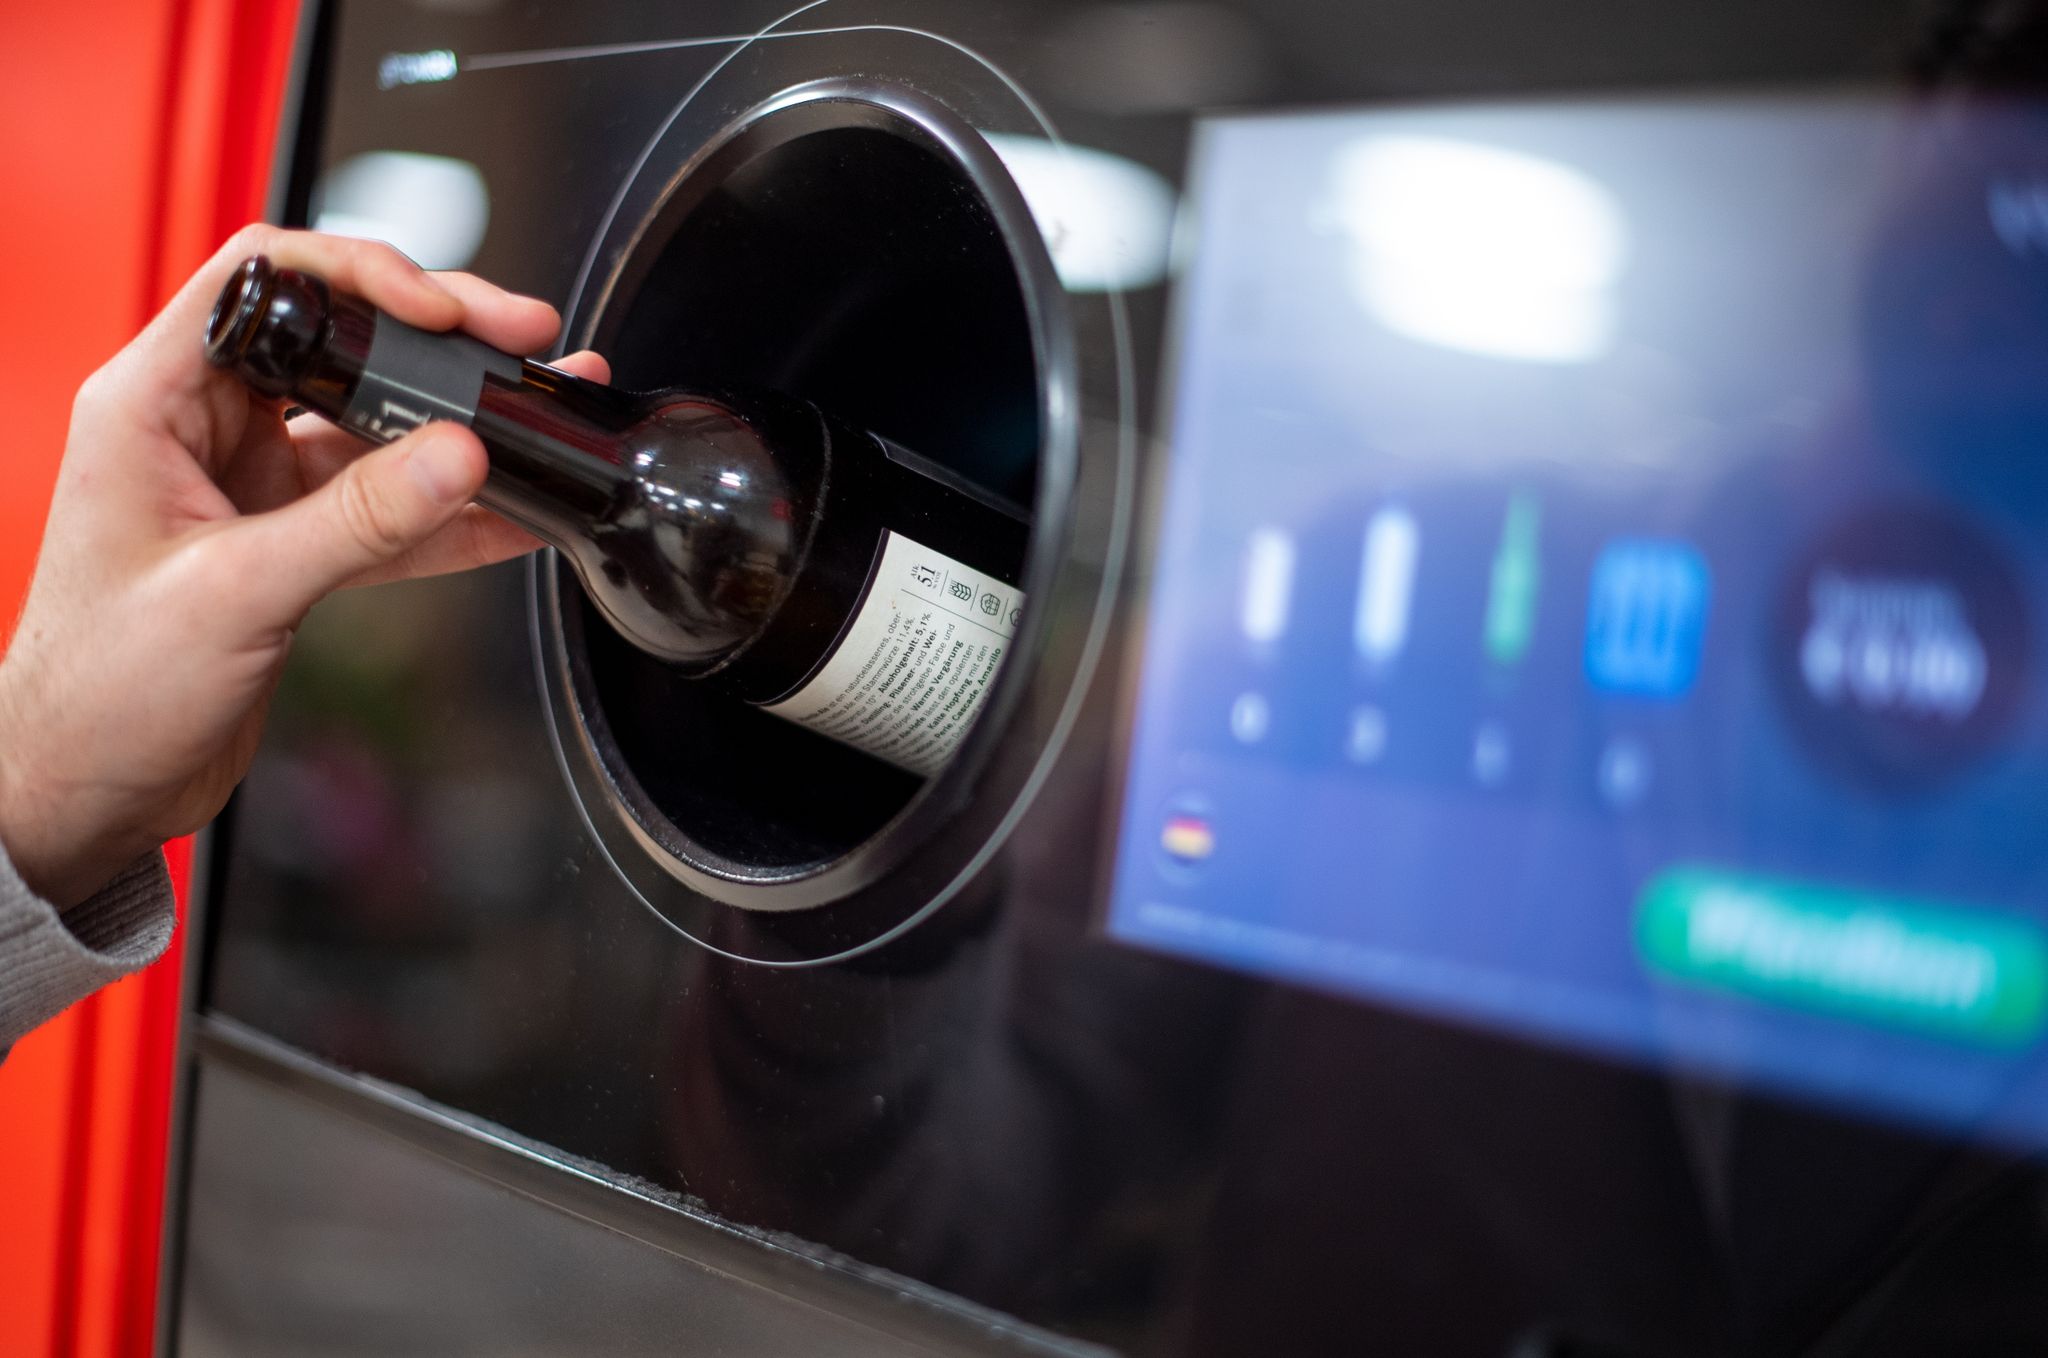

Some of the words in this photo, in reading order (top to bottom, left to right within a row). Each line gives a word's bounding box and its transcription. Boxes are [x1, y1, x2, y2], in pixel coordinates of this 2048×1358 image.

[887, 611, 901, 634] ober-
[853, 691, 866, 701] mit
[862, 645, 899, 691] Stammwürze
[878, 636, 919, 693] Alkoholgehalt:
[889, 667, 915, 698] Pilsener-
[914, 649, 927, 666] und
[922, 629, 937, 648] Wei-
[893, 704, 904, 713] die
[902, 666, 932, 704] strohgelbe
[928, 641, 946, 665] Farbe
[943, 623, 955, 640] und
[910, 685, 935, 709] Warme
[931, 639, 962, 683] Vergärung
[927, 712, 946, 729] Kalte
[942, 677, 972, 712] Hopfung
[968, 662, 979, 677] mit
[977, 645, 988, 661] den
[937, 685, 950, 700] den
[949, 644, 975, 685] opulenten
[952, 688, 981, 720] Cascade,
[977, 648, 1001, 685] Amarillo
